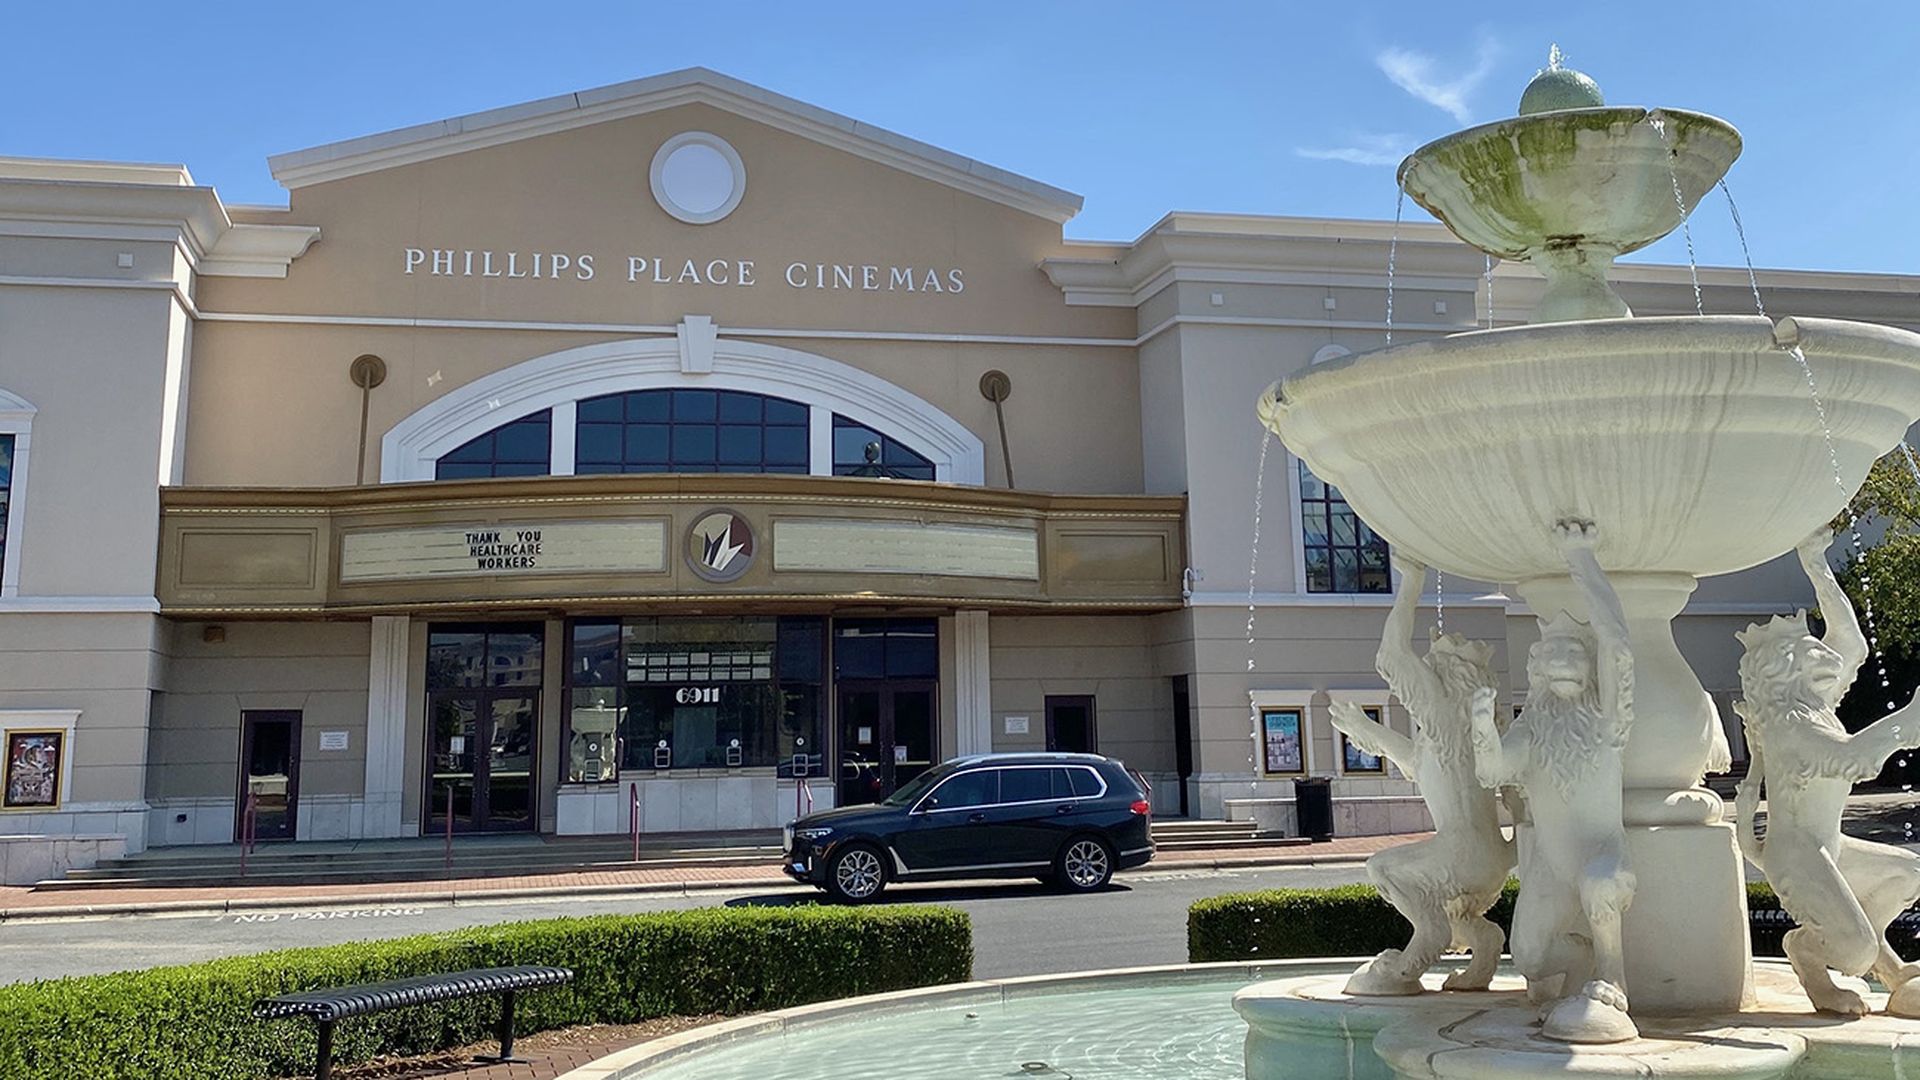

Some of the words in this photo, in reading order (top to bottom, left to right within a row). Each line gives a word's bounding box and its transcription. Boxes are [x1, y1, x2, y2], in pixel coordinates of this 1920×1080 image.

[404, 248, 595, 281] PHILLIPS
[627, 256, 757, 287] PLACE
[784, 261, 965, 294] CINEMAS
[465, 532, 501, 544] THANK
[517, 531, 542, 542] YOU
[470, 543, 542, 556] HEALTHCARE
[477, 556, 536, 569] WORKERS
[675, 687, 720, 704] 6911
[233, 913, 280, 924] NO
[290, 908, 425, 921] PARKING
